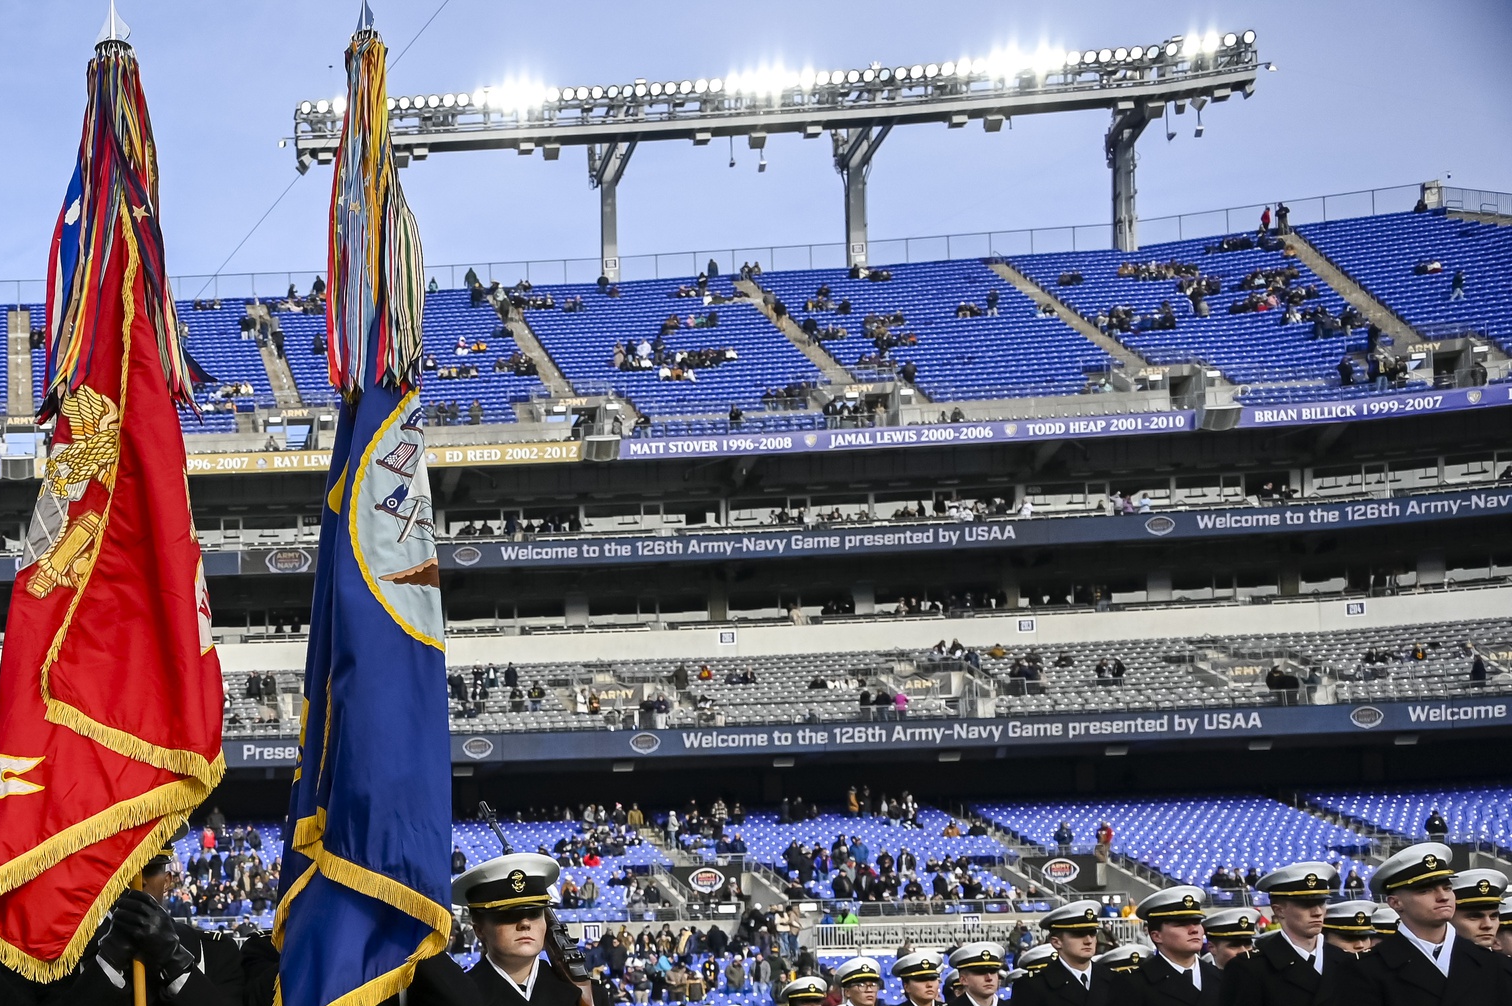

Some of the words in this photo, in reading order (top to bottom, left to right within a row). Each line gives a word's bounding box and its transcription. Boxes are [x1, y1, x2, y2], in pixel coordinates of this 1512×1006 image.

[1407, 343, 1441, 352] ARMY
[1139, 367, 1170, 376] ARMY
[844, 384, 873, 393] ARMY
[1255, 409, 1297, 423] BRIAN
[1302, 405, 1356, 420] BILLICK
[1362, 396, 1443, 415] 1999-2007
[7, 417, 35, 425] ARMY
[1027, 423, 1065, 436] TODD
[1069, 420, 1106, 434] HEAP
[1110, 415, 1185, 431] 2001-2010
[829, 432, 874, 448] JAMAL
[876, 430, 917, 445] LEWIS
[921, 426, 993, 441] 2000-2006
[445, 451, 463, 463] ED
[467, 449, 501, 461] REED
[506, 446, 578, 460] 2002-2012
[630, 442, 664, 455] MATT
[668, 440, 718, 454] STOVER
[722, 437, 792, 451] 1996-2008
[187, 457, 249, 471] 996-2007
[273, 456, 299, 467] RAY
[302, 454, 332, 466] LEW
[1197, 513, 1280, 530] Welcome
[1286, 511, 1304, 525] to
[1309, 508, 1339, 523] the
[1345, 504, 1400, 521] 126th
[1406, 494, 1512, 516] Army-Nav
[501, 545, 577, 561] Welcome
[583, 544, 600, 558] to
[604, 541, 631, 556] the
[636, 540, 683, 555] 126th
[688, 536, 787, 556] Army-Navy
[791, 533, 840, 549] Game
[845, 528, 934, 549] presented
[939, 526, 960, 546] by
[965, 525, 1016, 542] USAA
[1226, 666, 1262, 677] ARMY
[600, 689, 634, 700] ARMY
[1408, 703, 1507, 723] Welcome
[682, 731, 768, 749] Welcome
[773, 731, 792, 745] to
[796, 728, 828, 745] the
[833, 726, 886, 744] 126th
[892, 723, 1003, 744] Army-Navy
[1008, 720, 1063, 738] Game
[1068, 715, 1168, 738] presented
[1174, 713, 1198, 734] by
[1204, 712, 1262, 730] USAA
